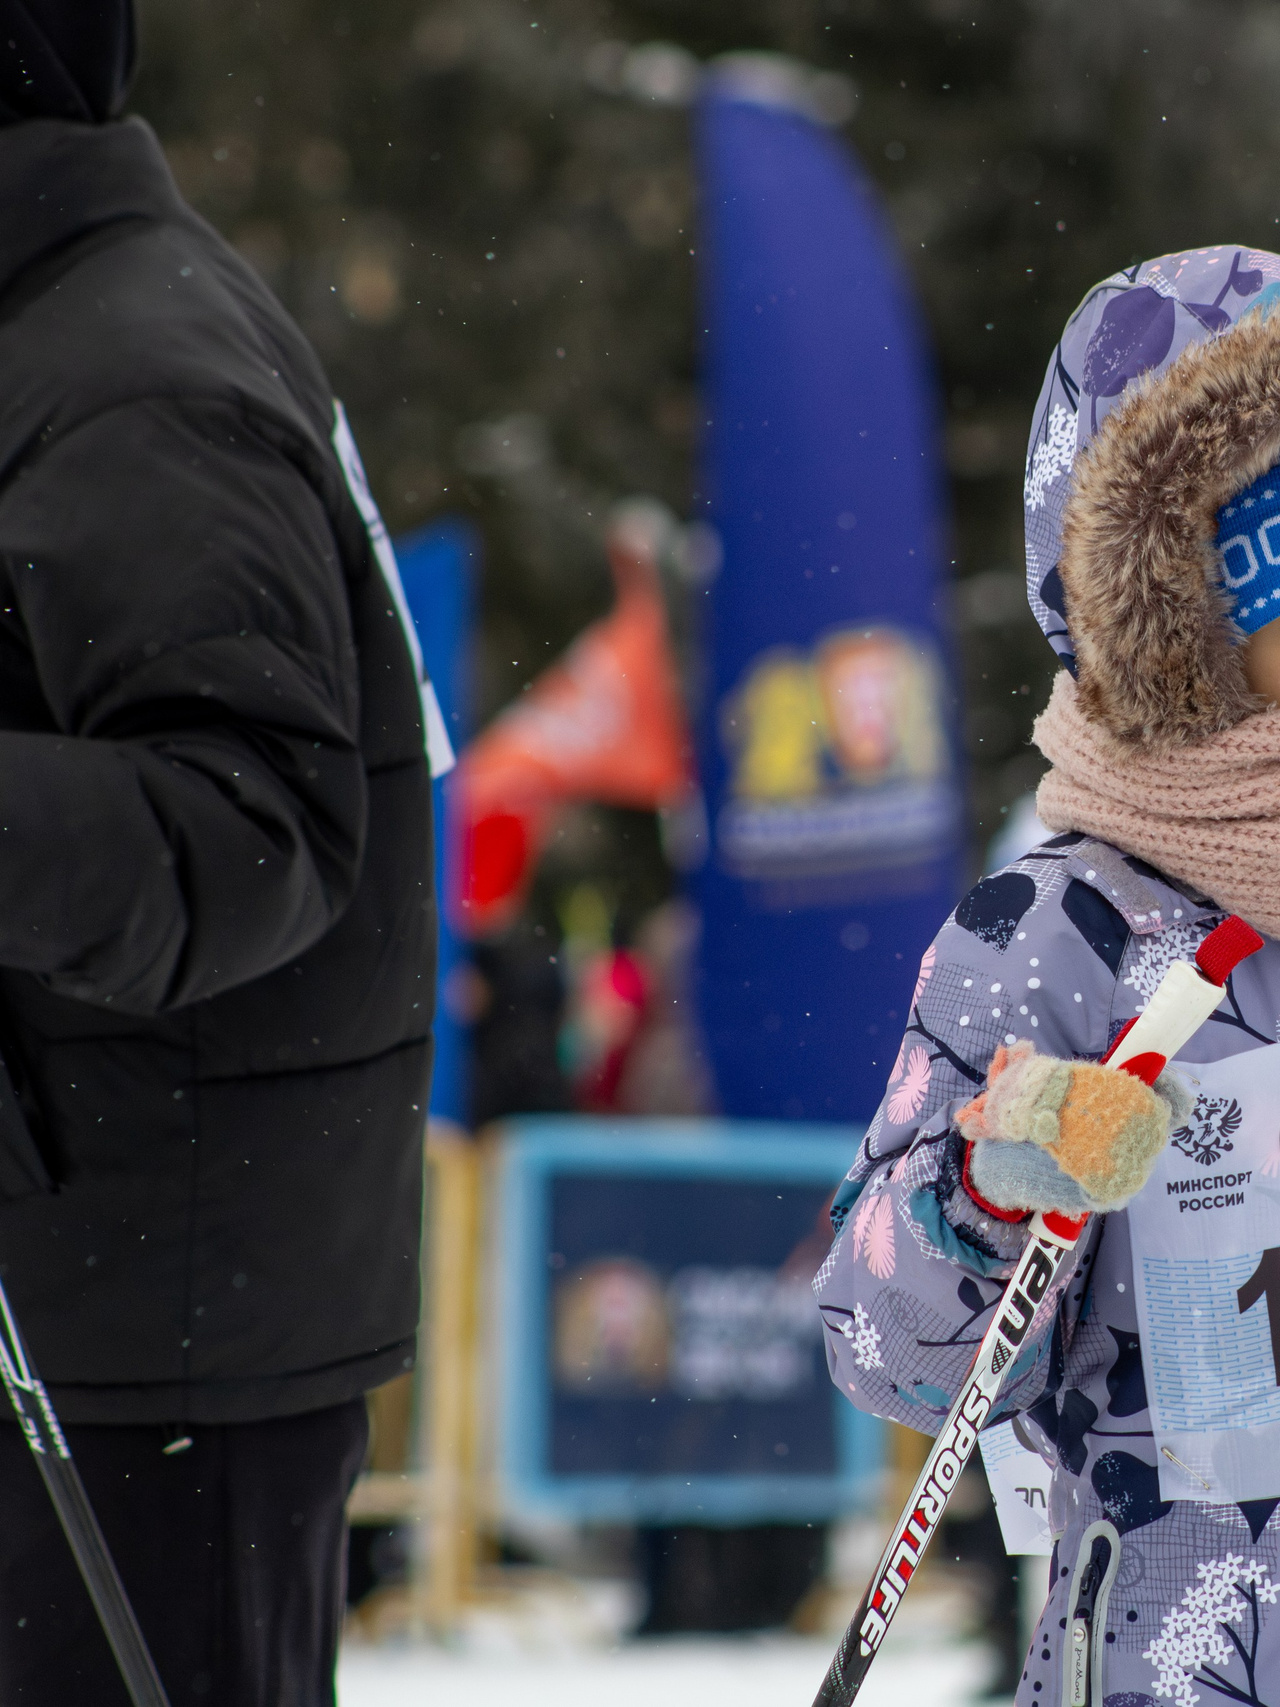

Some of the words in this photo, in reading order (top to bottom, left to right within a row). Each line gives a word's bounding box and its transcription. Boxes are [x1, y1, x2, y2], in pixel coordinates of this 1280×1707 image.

[1166, 1170, 1253, 1196] МИНСПОРТ
[1178, 1191, 1245, 1213] РОССИИ
[858, 1381, 991, 1654] SPORTLIFE
